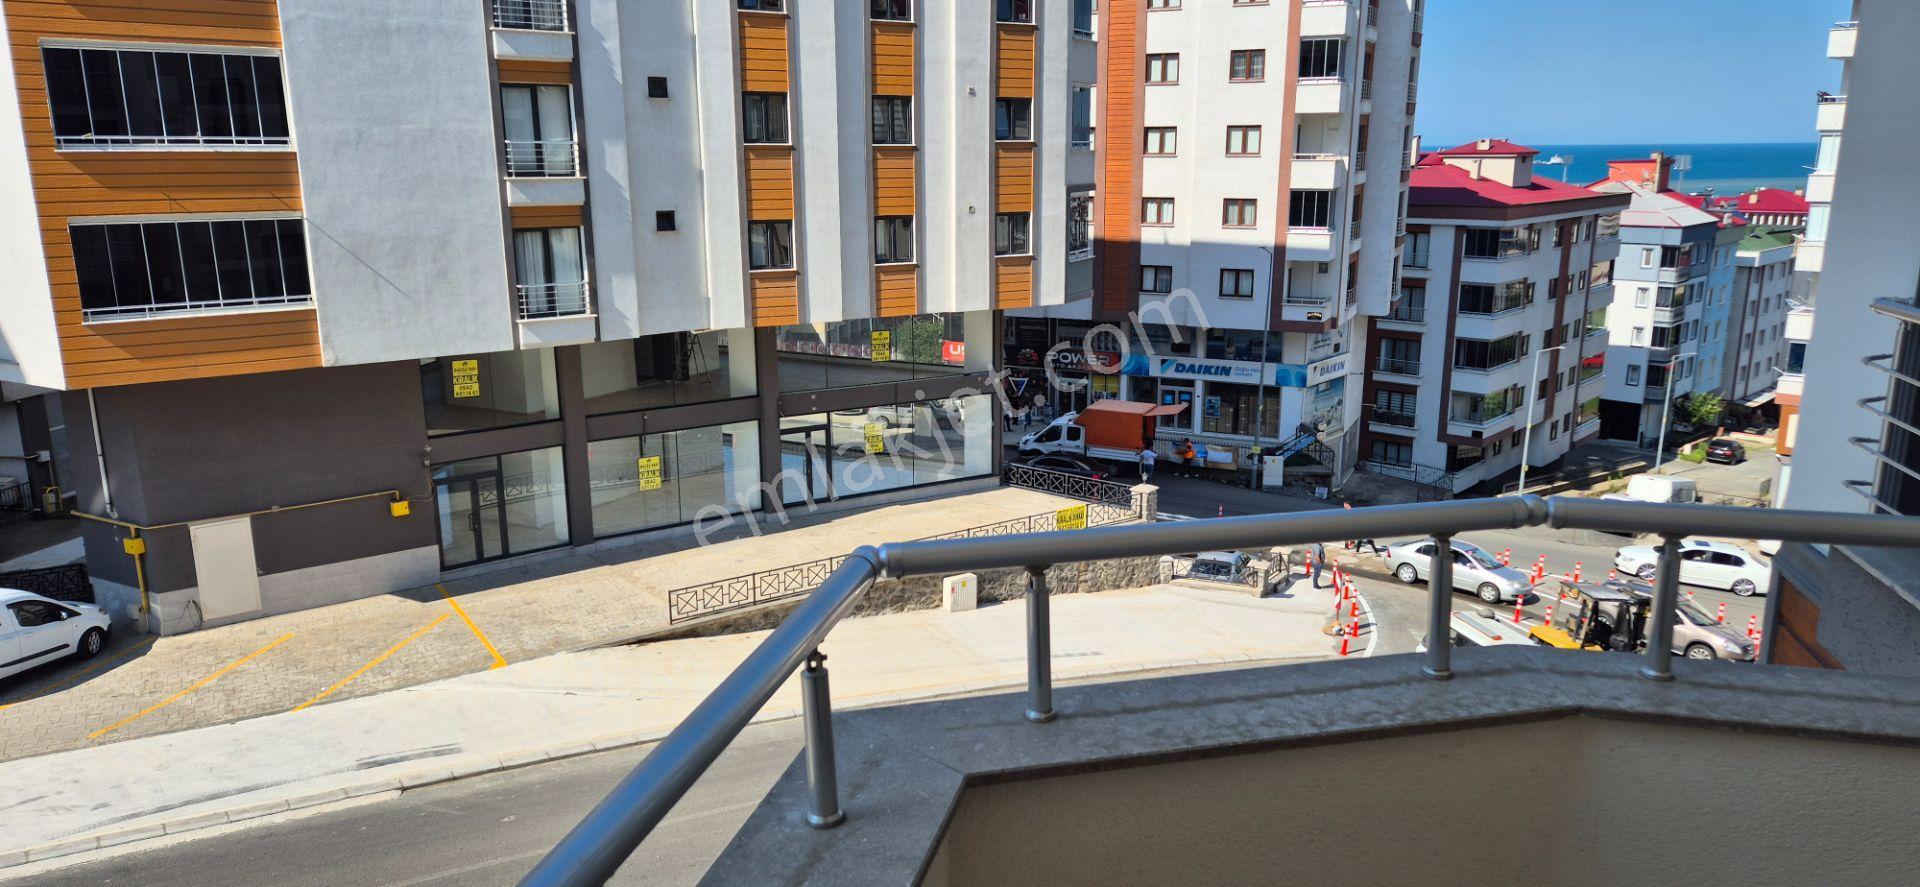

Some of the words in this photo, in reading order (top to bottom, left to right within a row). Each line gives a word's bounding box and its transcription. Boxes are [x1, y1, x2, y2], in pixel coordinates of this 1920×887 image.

[1047, 352, 1111, 366] POWER
[1174, 363, 1232, 377] DAIKIN
[1320, 360, 1346, 376] DAIKIN
